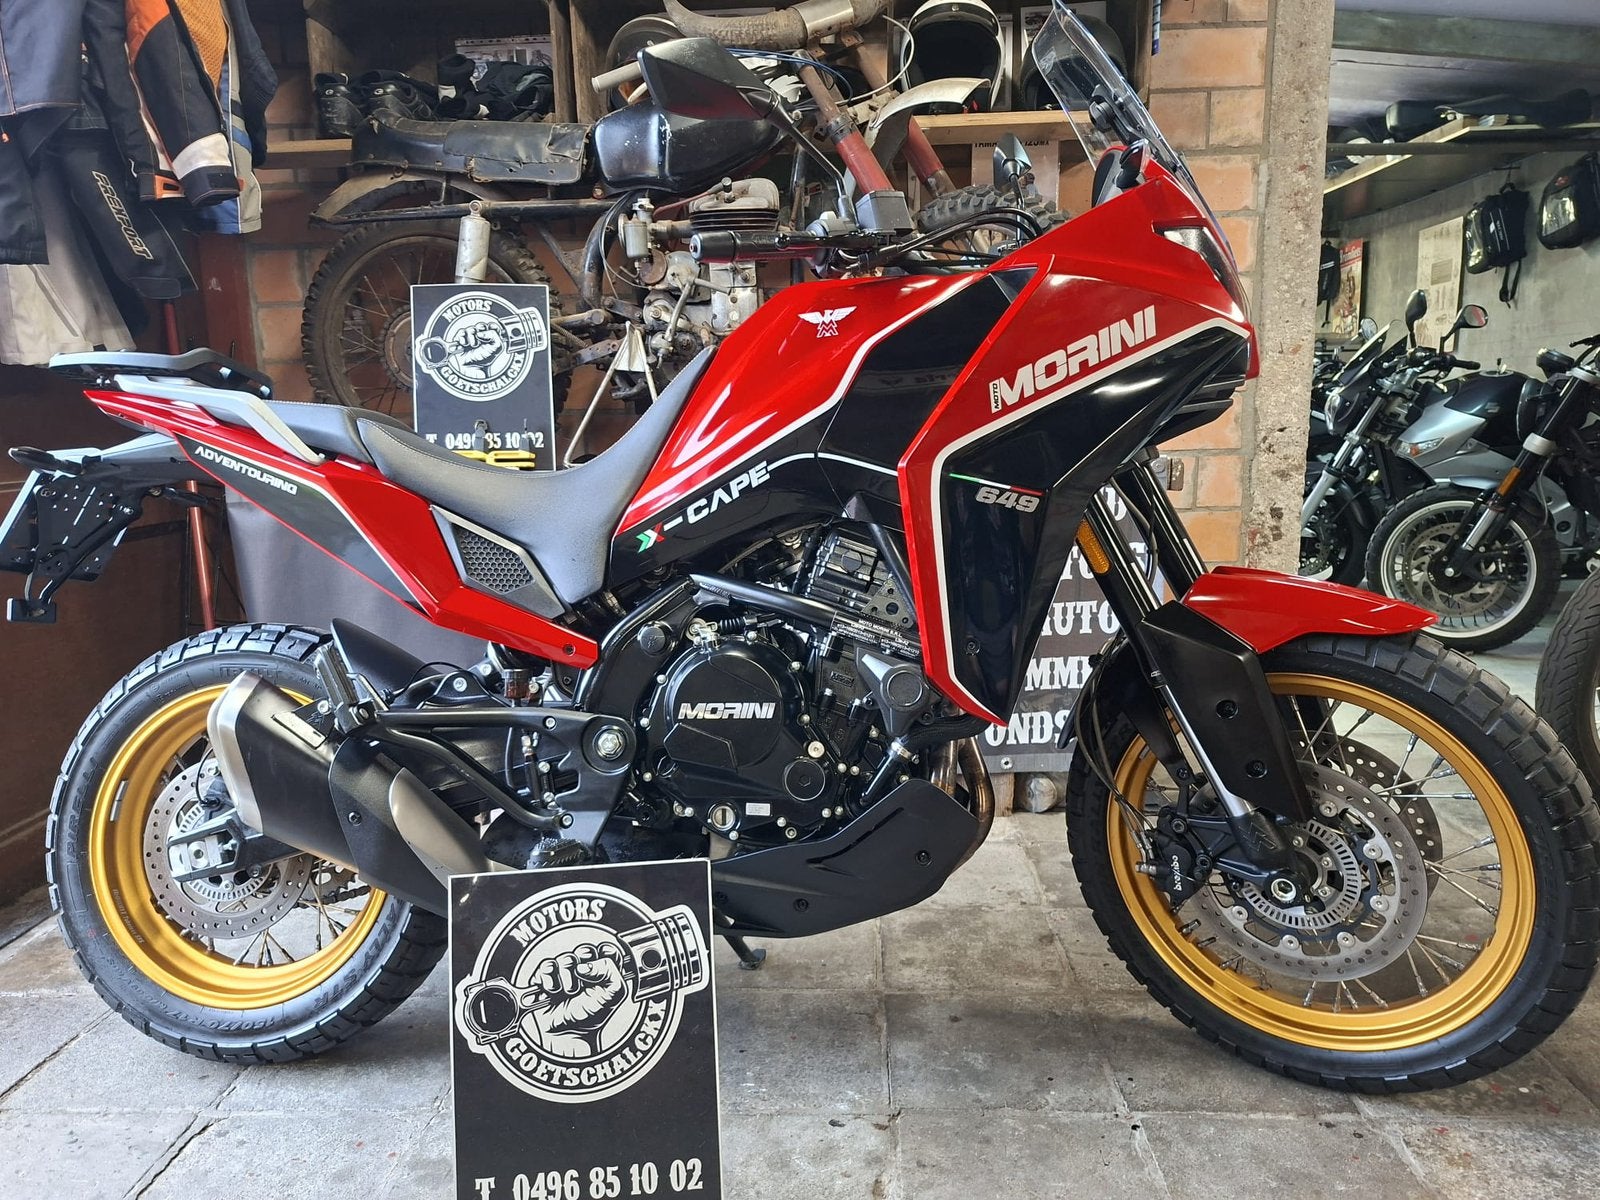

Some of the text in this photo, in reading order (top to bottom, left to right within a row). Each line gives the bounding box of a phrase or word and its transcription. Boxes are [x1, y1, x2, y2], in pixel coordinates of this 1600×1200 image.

[91, 170, 154, 259] PREXPORT
[442, 299, 493, 322] MOTORS
[999, 304, 1157, 406] MORINI
[636, 460, 771, 553] X-CAPE
[975, 486, 1041, 513] 649
[677, 702, 776, 720] MORINI
[363, 902, 399, 974] ALLY
[508, 898, 607, 949] MOTORS
[505, 998, 668, 1087] GOETSCHALCKX
[475, 1158, 703, 1200] T 0496 85 10 02
